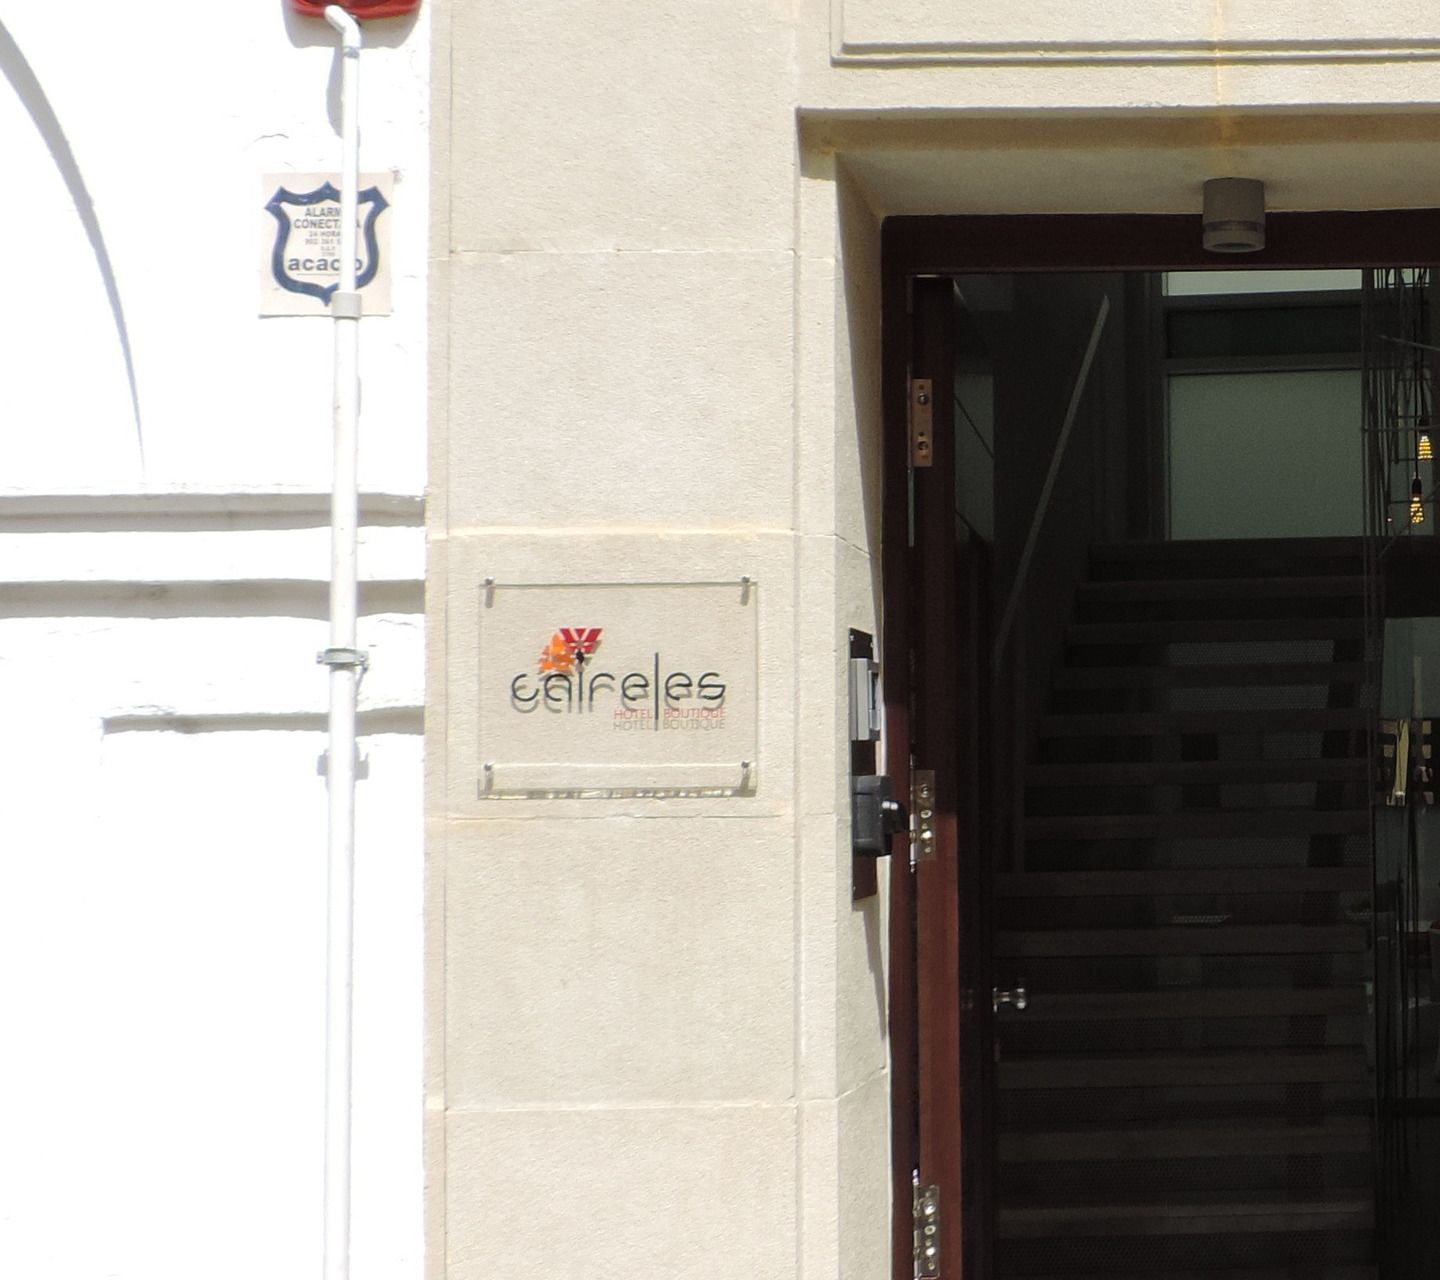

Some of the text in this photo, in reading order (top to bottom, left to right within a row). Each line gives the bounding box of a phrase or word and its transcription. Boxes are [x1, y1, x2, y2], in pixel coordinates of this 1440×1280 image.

[305, 207, 341, 217] ALARM
[613, 706, 726, 720] HOTEL BOUTIQUE
